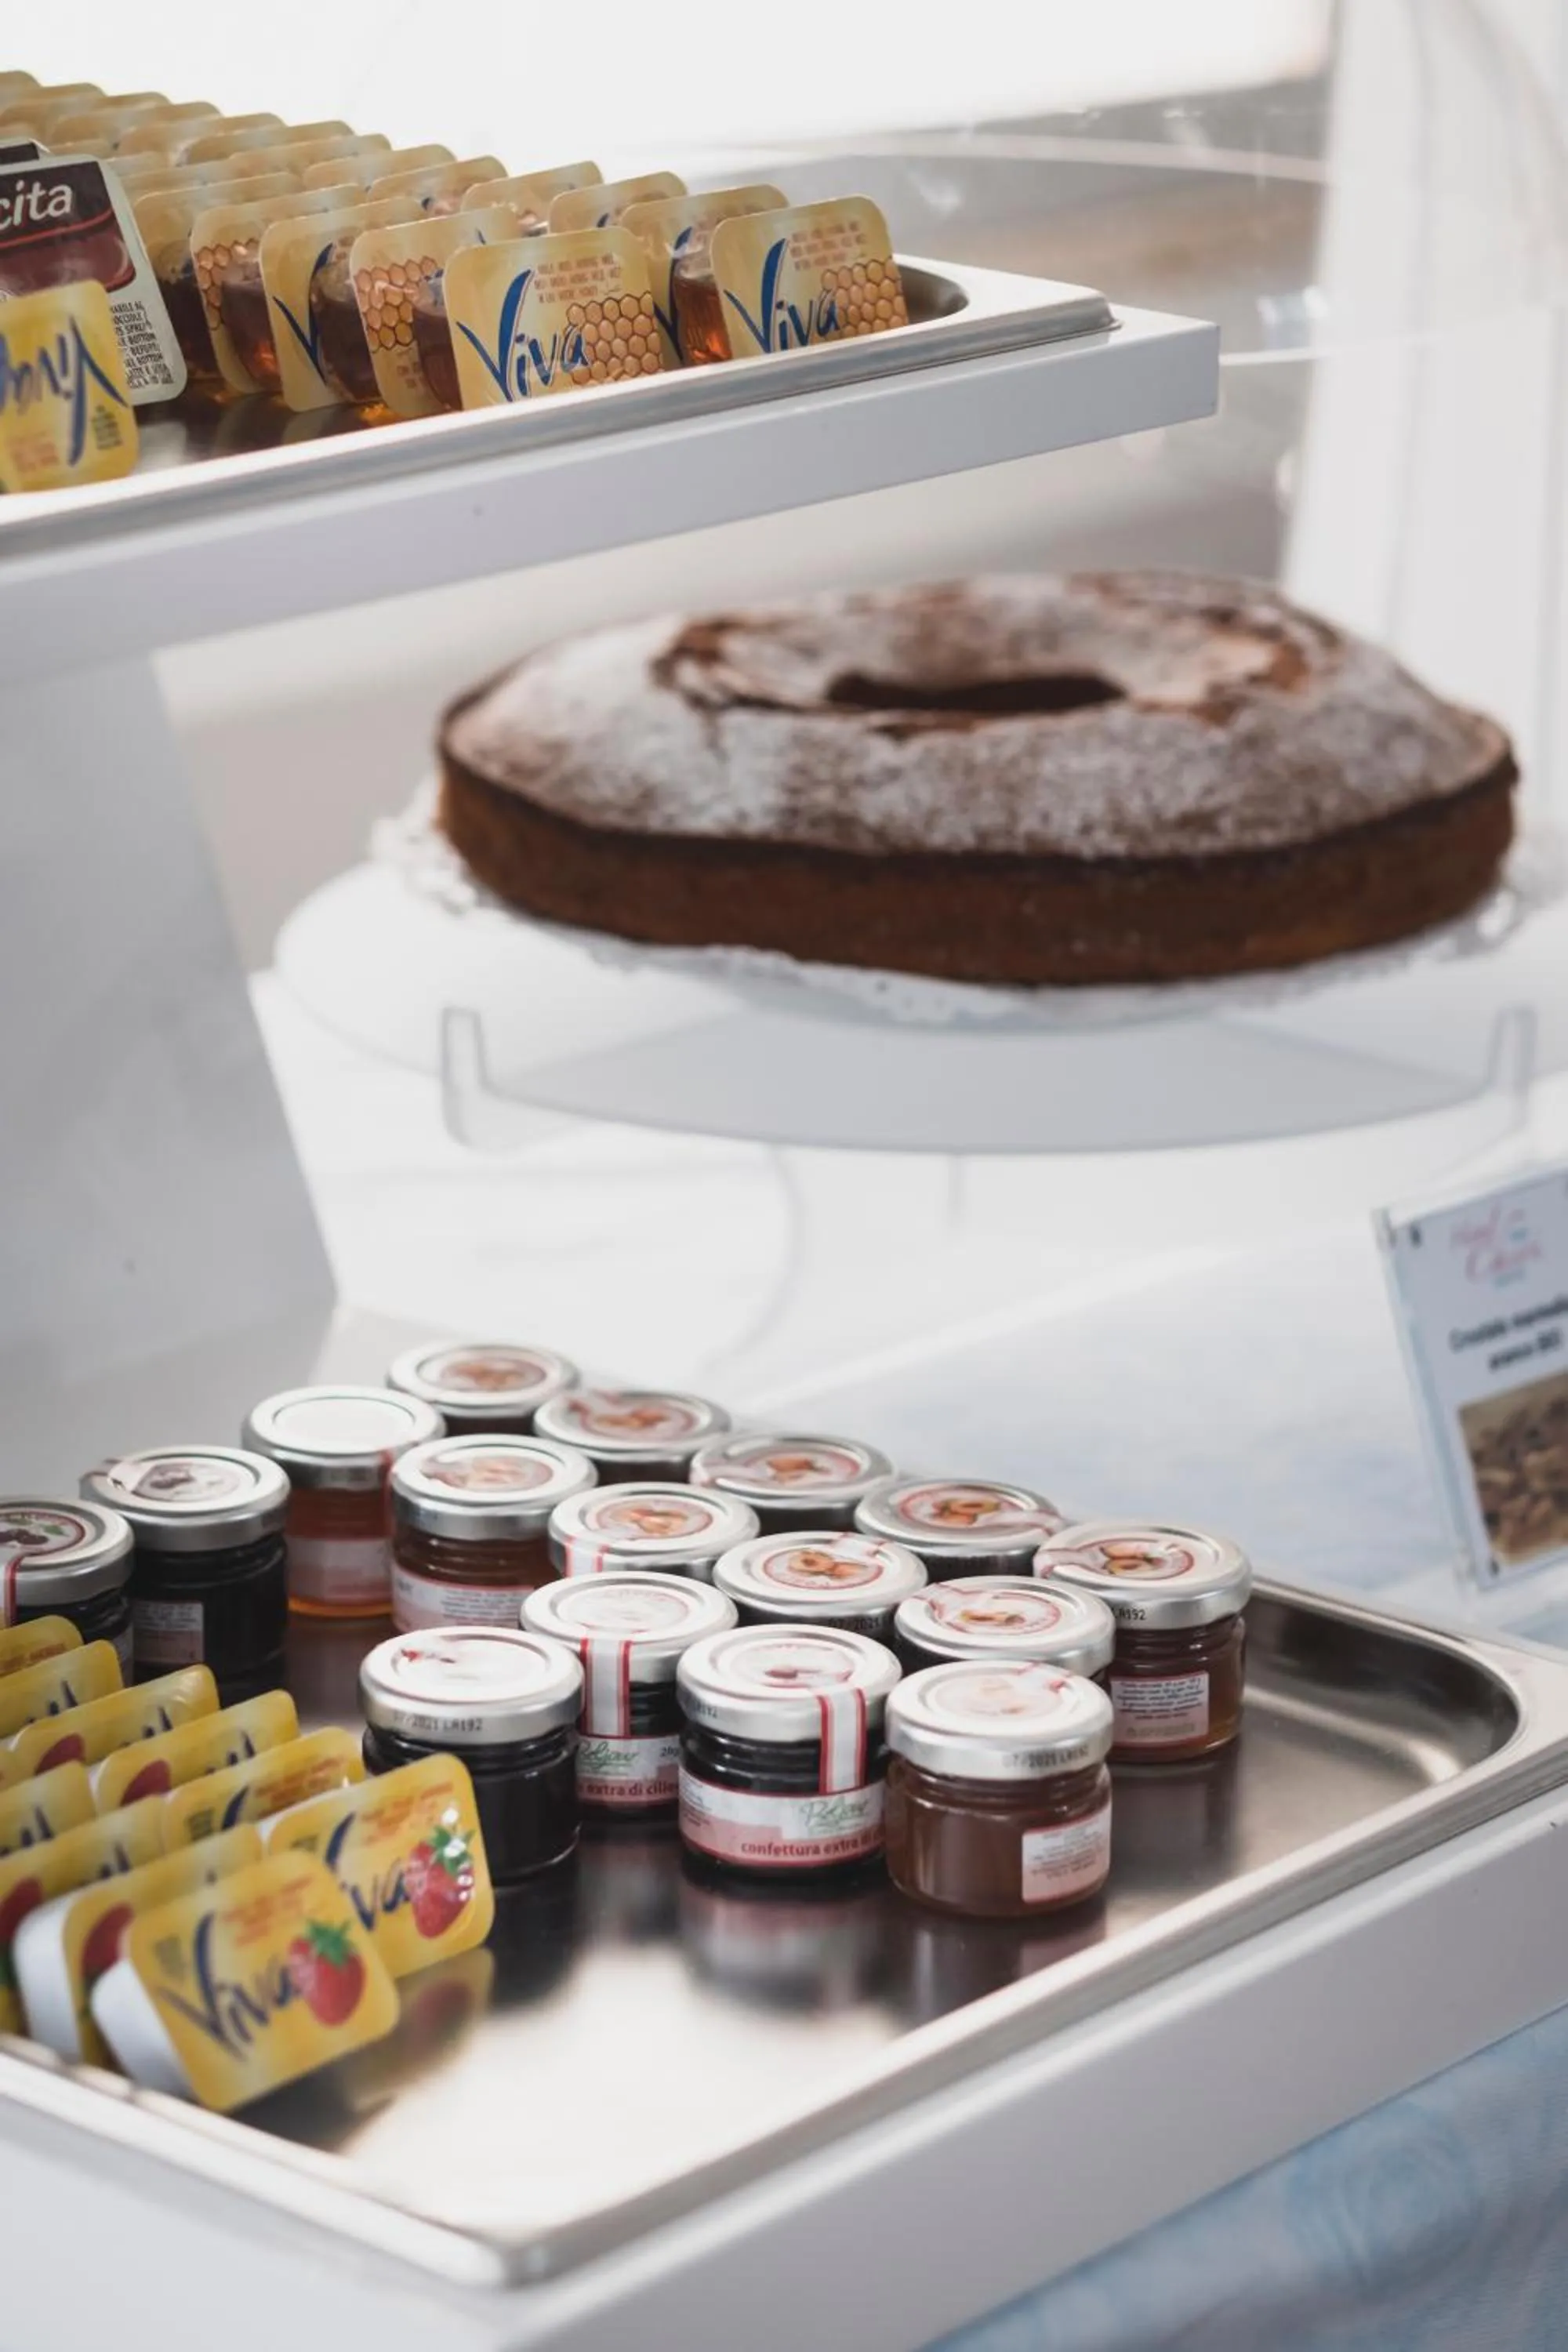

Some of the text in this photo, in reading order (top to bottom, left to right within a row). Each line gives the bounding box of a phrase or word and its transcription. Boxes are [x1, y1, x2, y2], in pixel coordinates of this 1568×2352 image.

[456, 268, 590, 402] Viva
[723, 238, 840, 354] Viva
[586, 1784, 626, 1796] extra
[628, 1782, 642, 1796] di
[741, 1842, 821, 1857] confettura
[824, 1838, 859, 1856] extra
[158, 1909, 303, 2062] Viva
